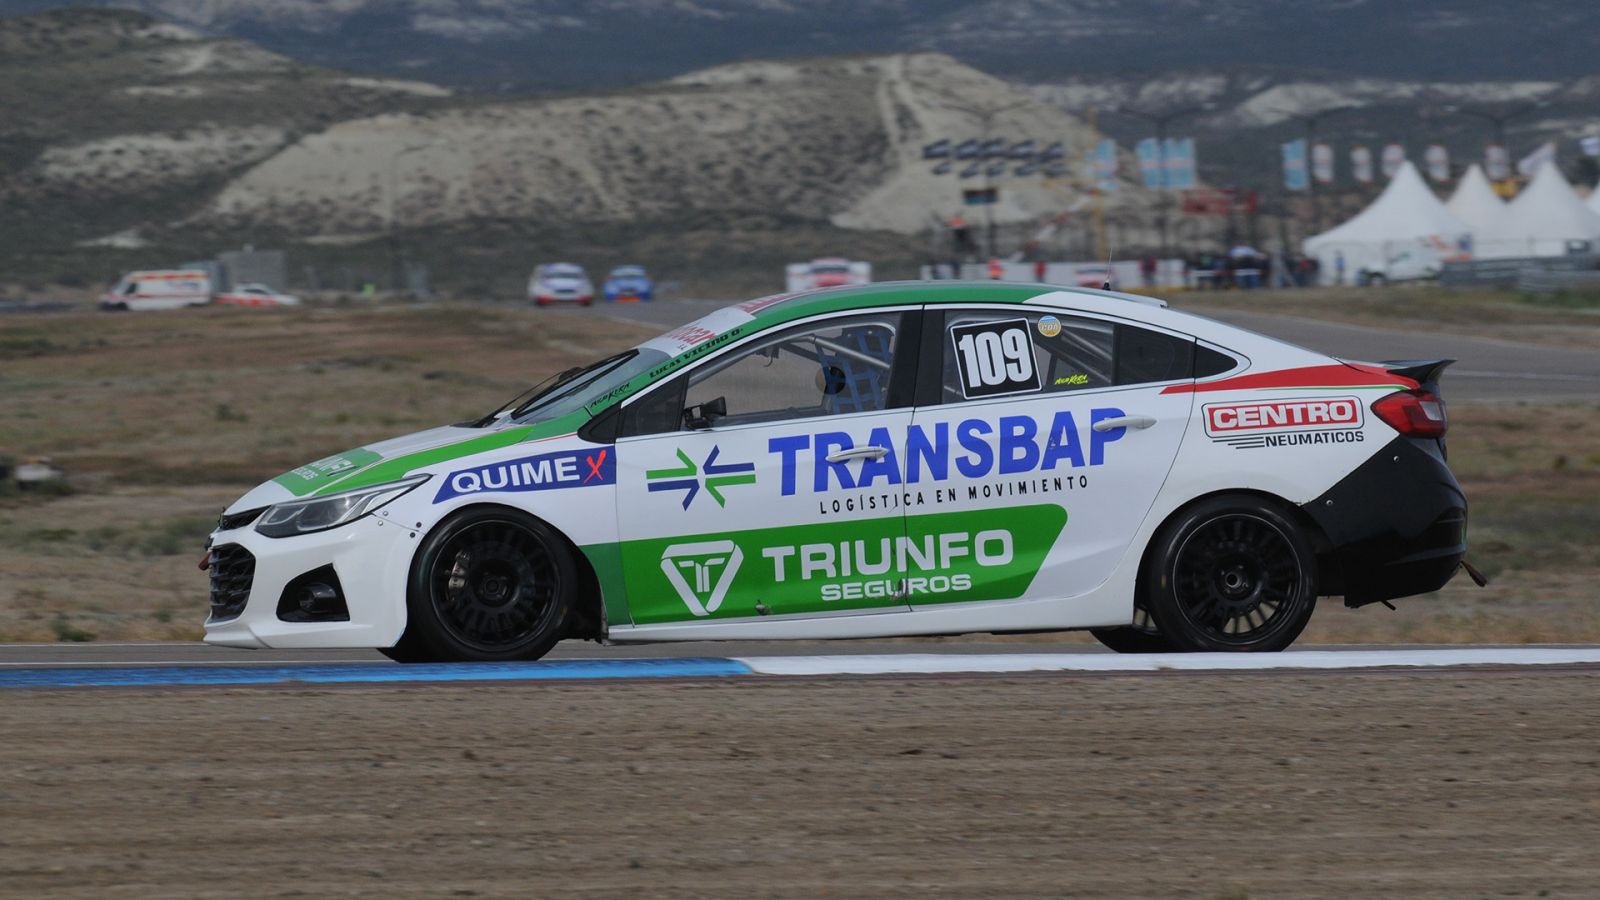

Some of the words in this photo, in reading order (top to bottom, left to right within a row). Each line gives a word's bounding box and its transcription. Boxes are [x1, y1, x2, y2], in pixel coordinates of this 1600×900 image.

[649, 358, 681, 378] LUCAS
[684, 333, 729, 359] VICINO
[958, 328, 1033, 388] 109
[1213, 401, 1353, 428] CENTRO
[768, 407, 1126, 496] TRANSBAP
[1265, 431, 1364, 447] NEUMATICOS
[819, 492, 924, 514] LOGÍSTICA
[936, 489, 956, 503] EN
[968, 475, 1088, 500] MOVIMIENTO
[762, 529, 1013, 581] TRIUNFO
[821, 574, 972, 601] SEGUROS
